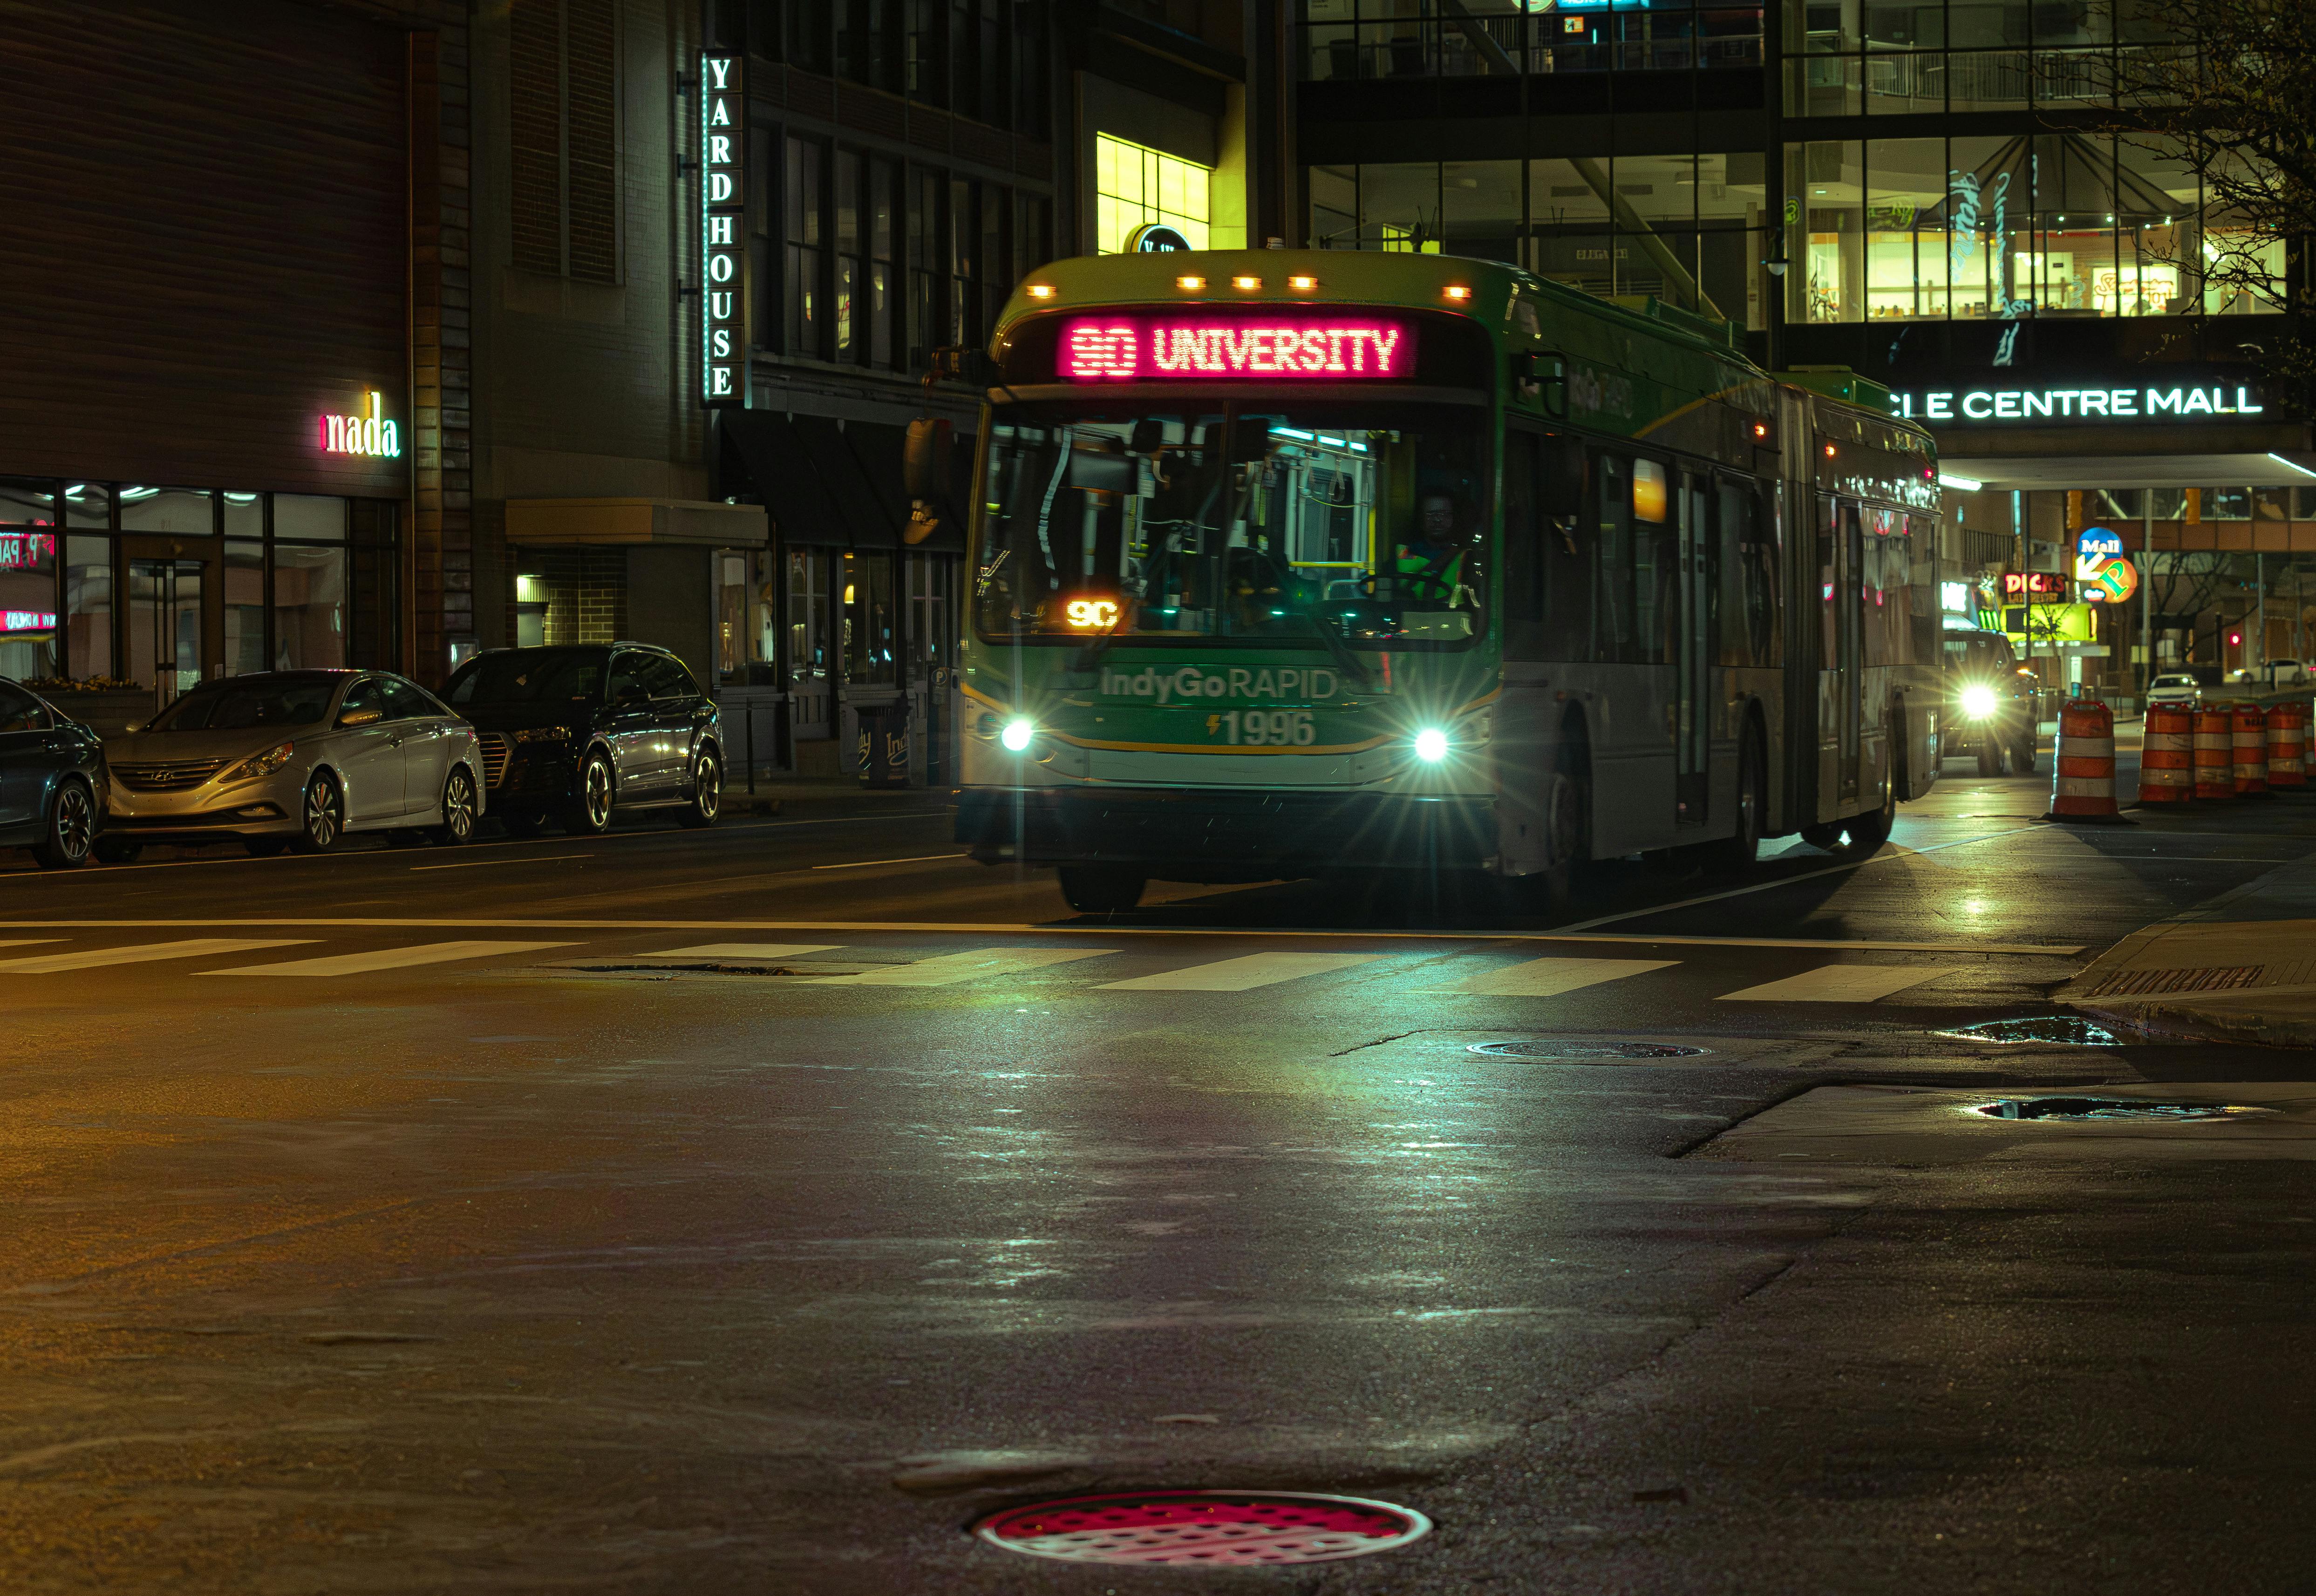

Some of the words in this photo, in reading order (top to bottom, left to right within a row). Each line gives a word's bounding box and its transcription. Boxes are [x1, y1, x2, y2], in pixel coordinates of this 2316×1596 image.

[709, 59, 732, 201] YARD
[710, 217, 733, 395] HOUSE
[1152, 328, 1399, 371] UNIVERSITY
[1962, 389, 2139, 418] CENTRE
[2146, 387, 2263, 415] MALL
[326, 391, 401, 458] nada
[2081, 539, 2120, 553] Mall
[2098, 560, 2129, 599] P
[1221, 710, 1316, 745] 1996
